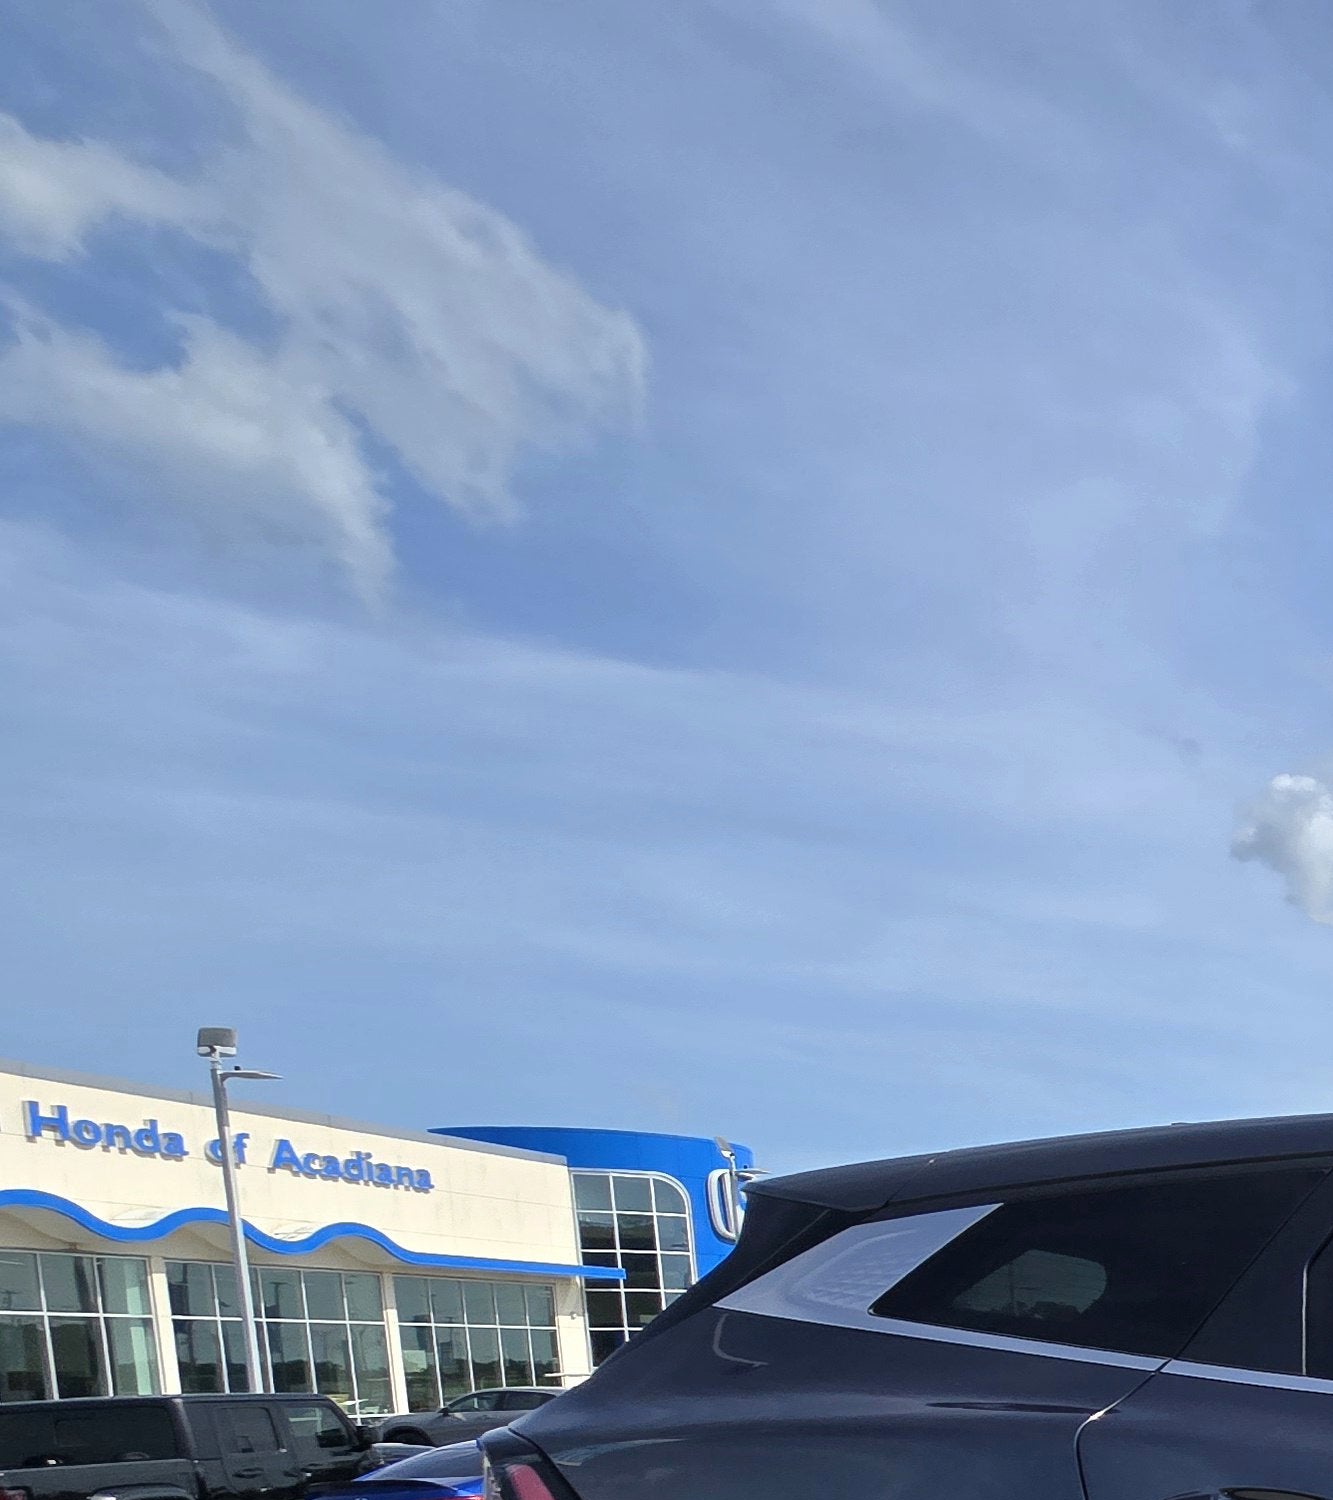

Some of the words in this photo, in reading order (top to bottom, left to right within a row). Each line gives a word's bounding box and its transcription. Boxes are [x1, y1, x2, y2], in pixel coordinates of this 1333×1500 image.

[23, 1100, 189, 1161] Honda
[205, 1132, 250, 1168] of
[268, 1139, 435, 1193] Acadiana
